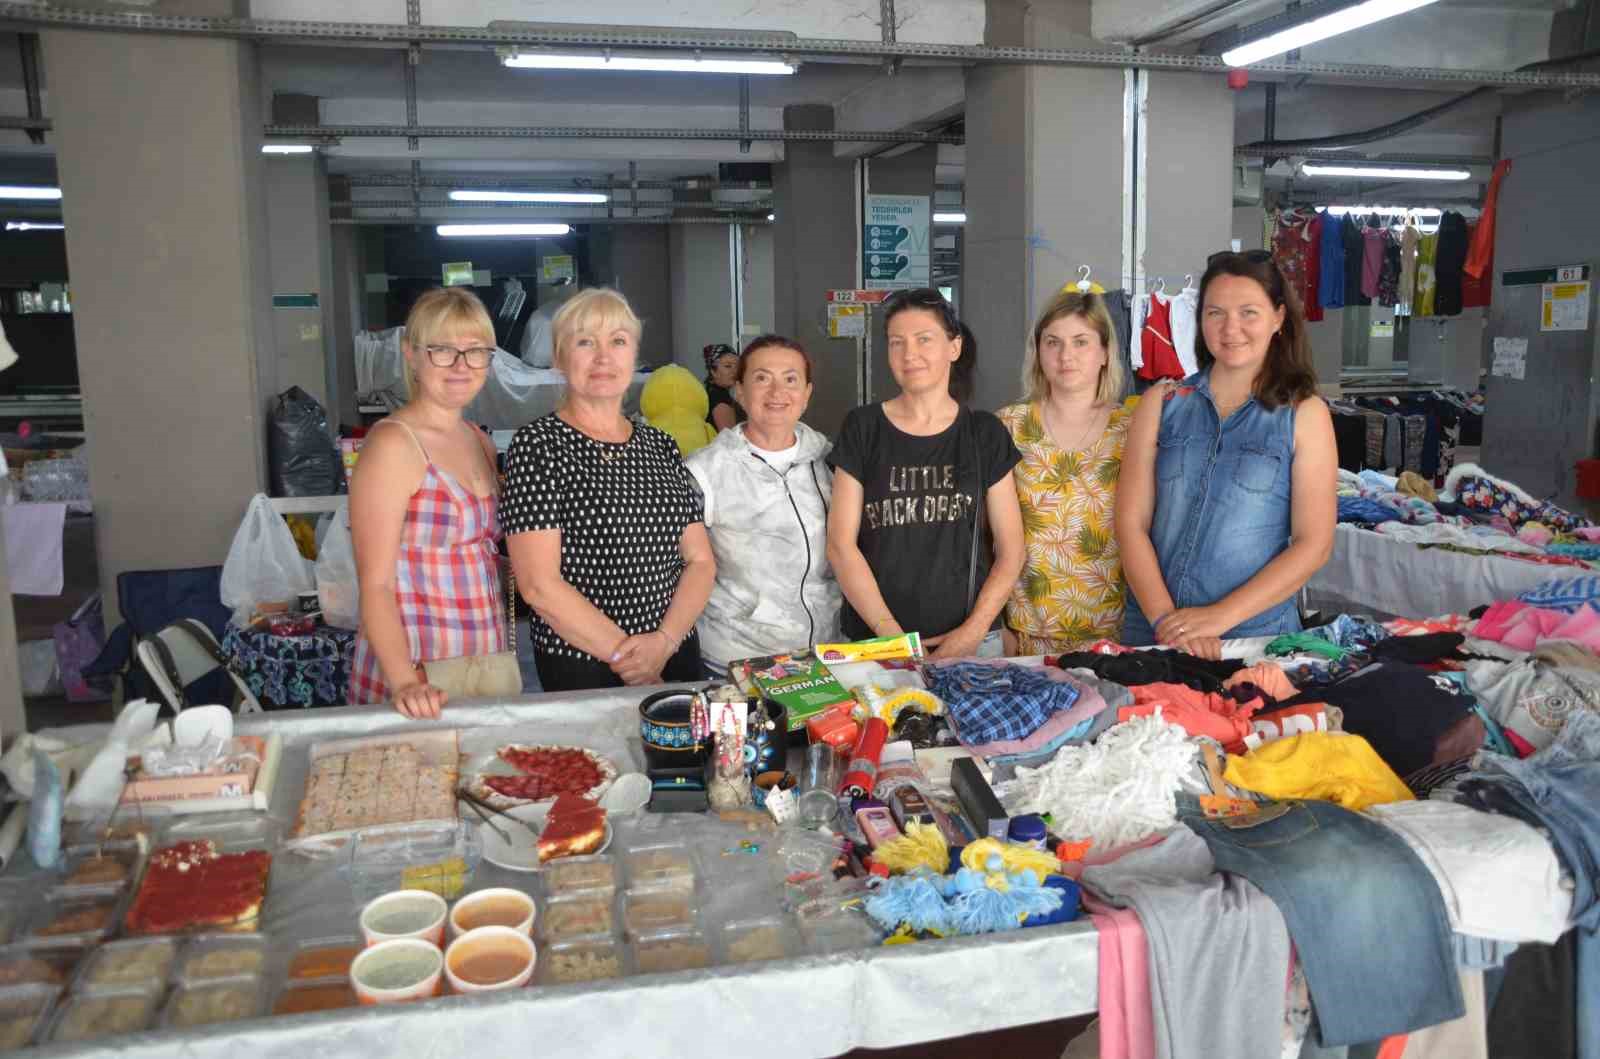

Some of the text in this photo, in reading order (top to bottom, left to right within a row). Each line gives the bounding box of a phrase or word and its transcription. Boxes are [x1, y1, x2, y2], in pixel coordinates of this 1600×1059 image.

[836, 292, 852, 300] 122
[889, 465, 955, 492] LITTLE
[769, 675, 837, 695] GERMAN
